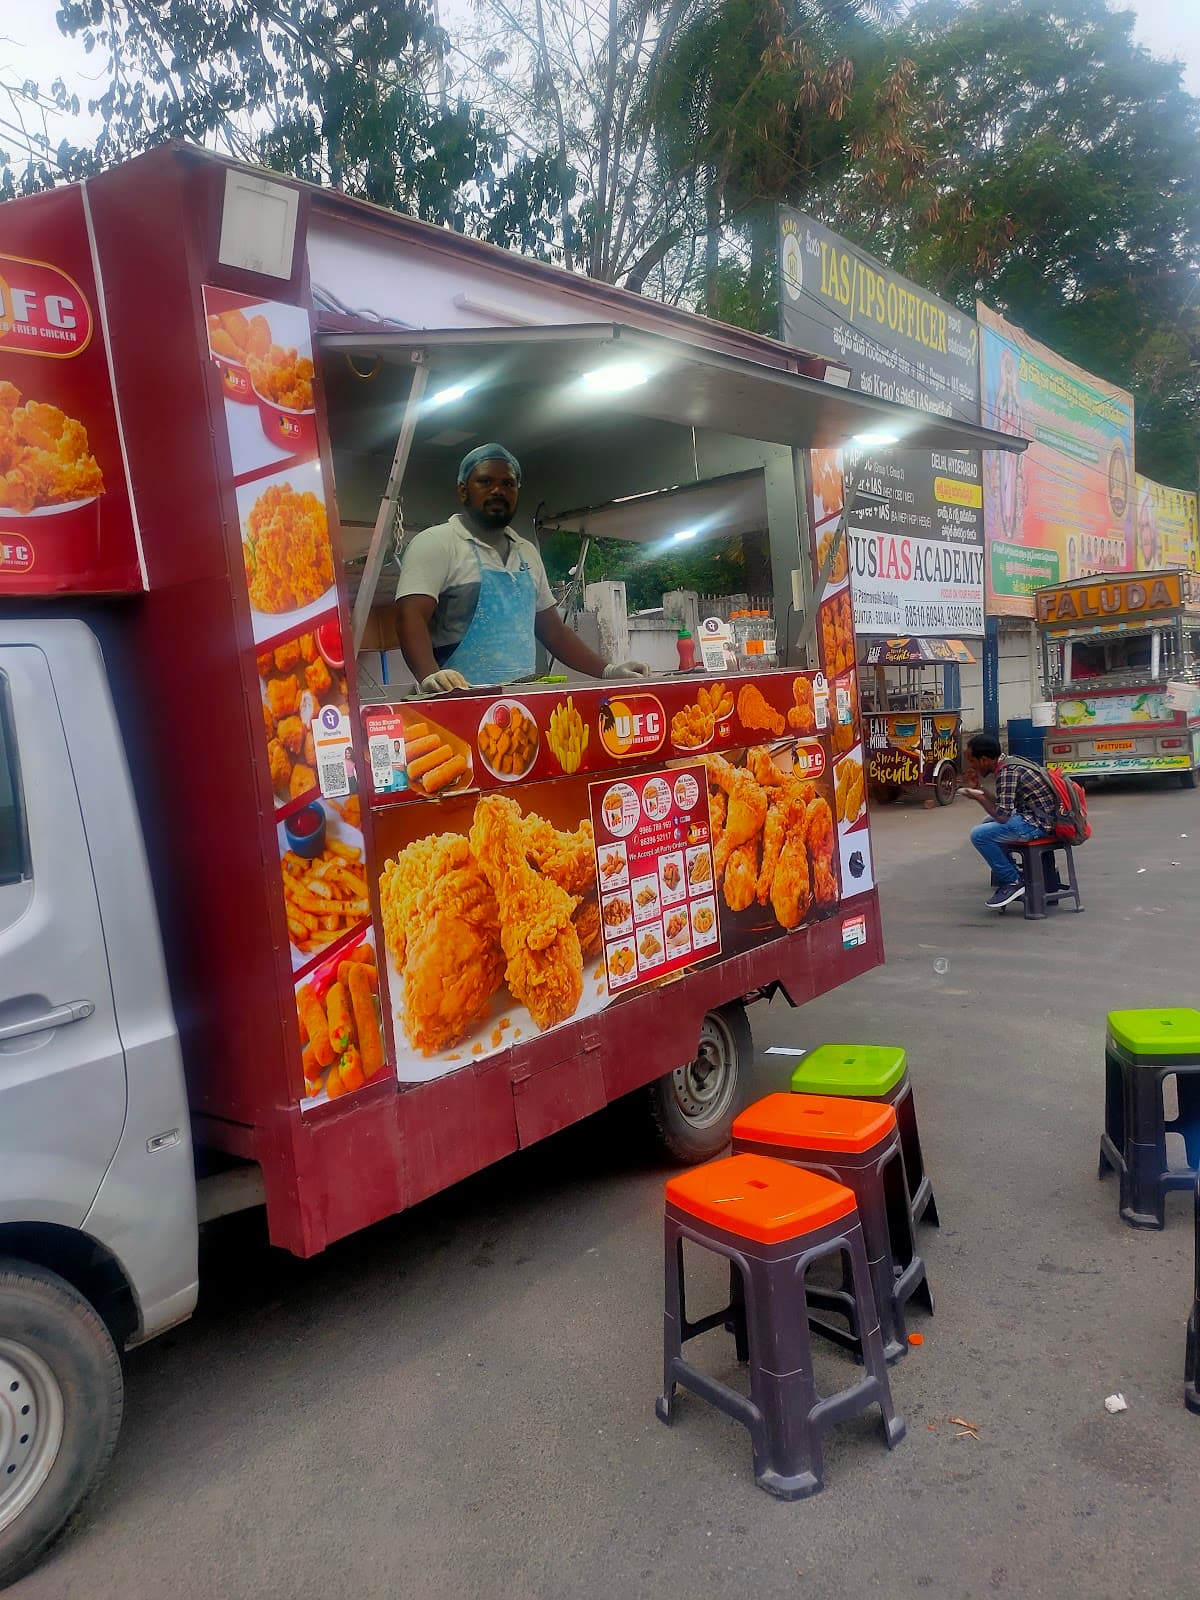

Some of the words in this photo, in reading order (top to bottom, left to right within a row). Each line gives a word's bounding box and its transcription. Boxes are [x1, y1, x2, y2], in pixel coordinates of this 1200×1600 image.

[820, 240, 886, 326] IAS/IPS
[887, 281, 948, 355] OFFICER
[12, 323, 38, 336] FRIED
[40, 328, 77, 342] CHICKEN
[947, 458, 978, 478] HYDERABAD
[877, 535, 912, 582] IAS
[913, 544, 984, 585] ACADEMY
[1038, 580, 1173, 622] FALUDA
[614, 712, 660, 738] UFC
[869, 735, 889, 750] MORE
[799, 753, 823, 769] UFC
[869, 756, 919, 785] Biscuits
